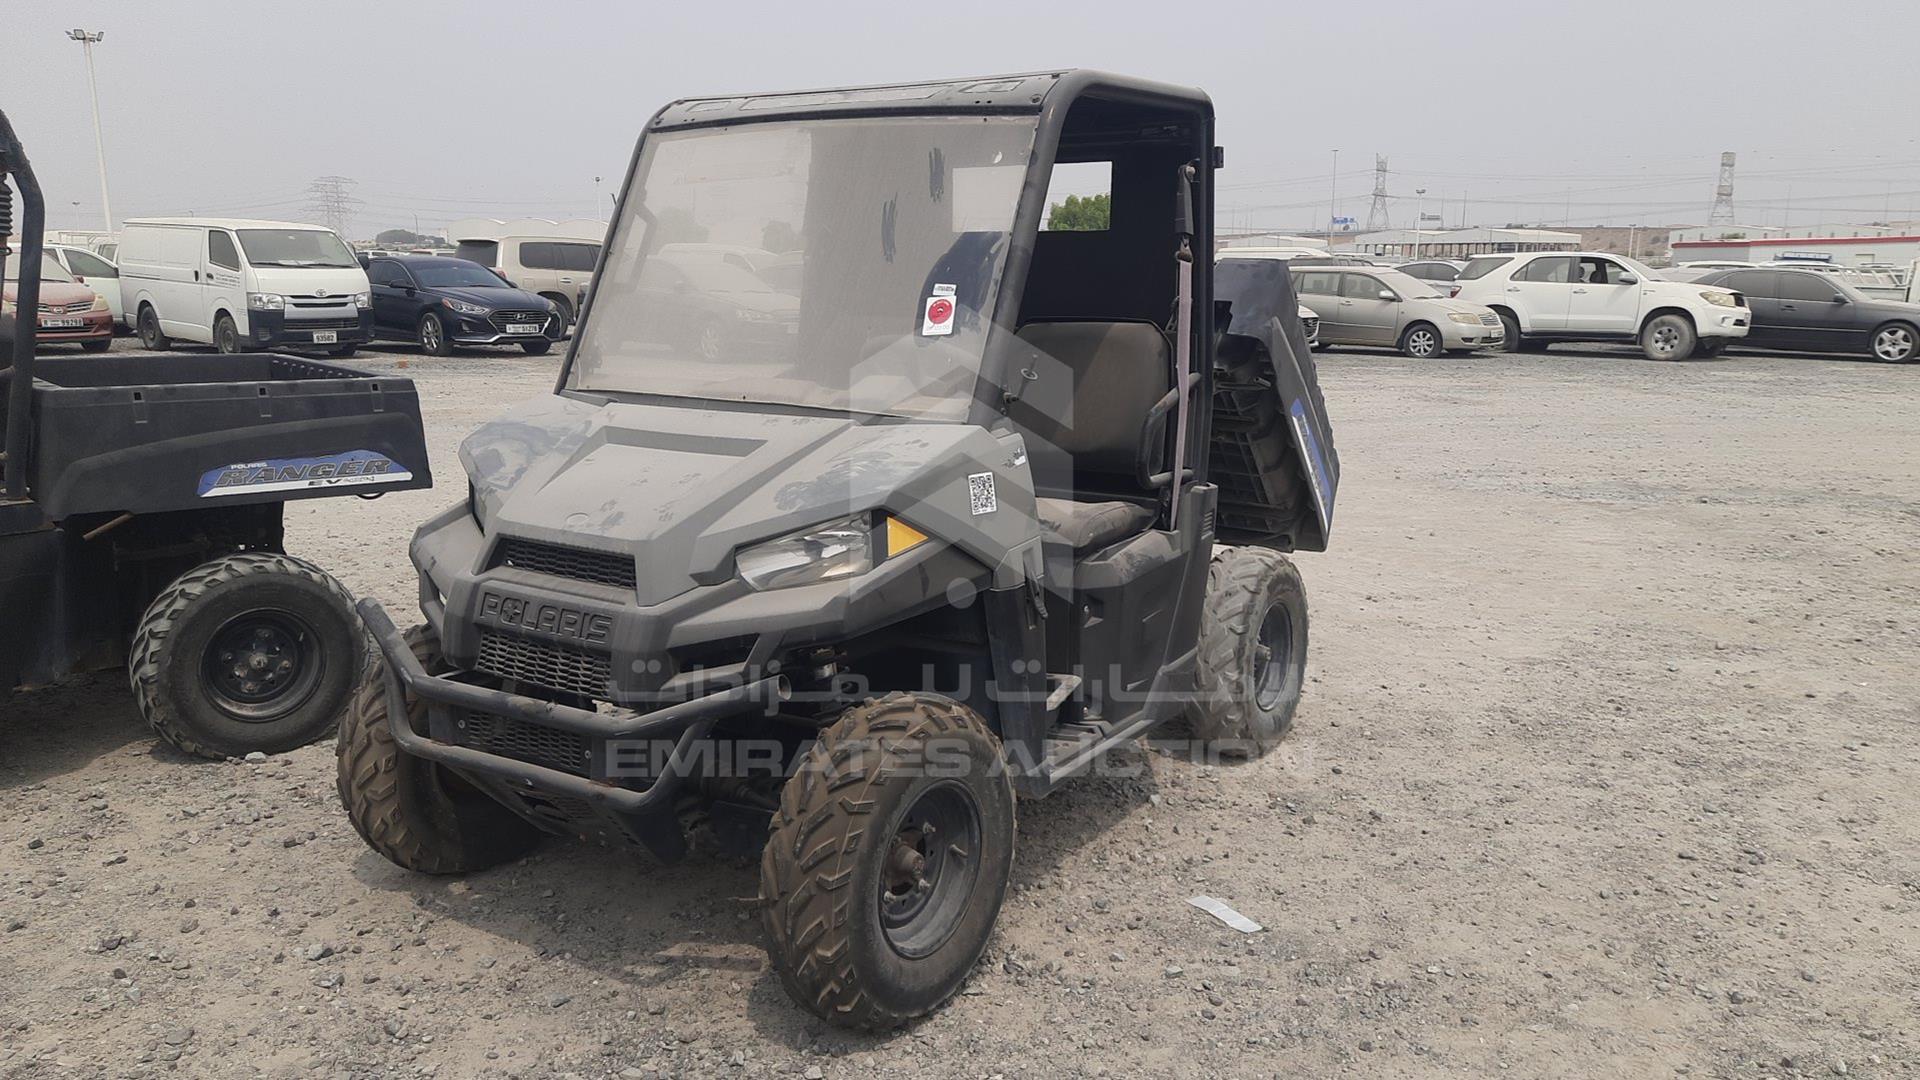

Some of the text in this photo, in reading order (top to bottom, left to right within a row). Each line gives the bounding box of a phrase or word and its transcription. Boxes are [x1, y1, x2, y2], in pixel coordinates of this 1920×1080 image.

[215, 458, 391, 488] RANGER
[230, 461, 267, 470] POLARIS
[480, 591, 612, 644] POLARIS
